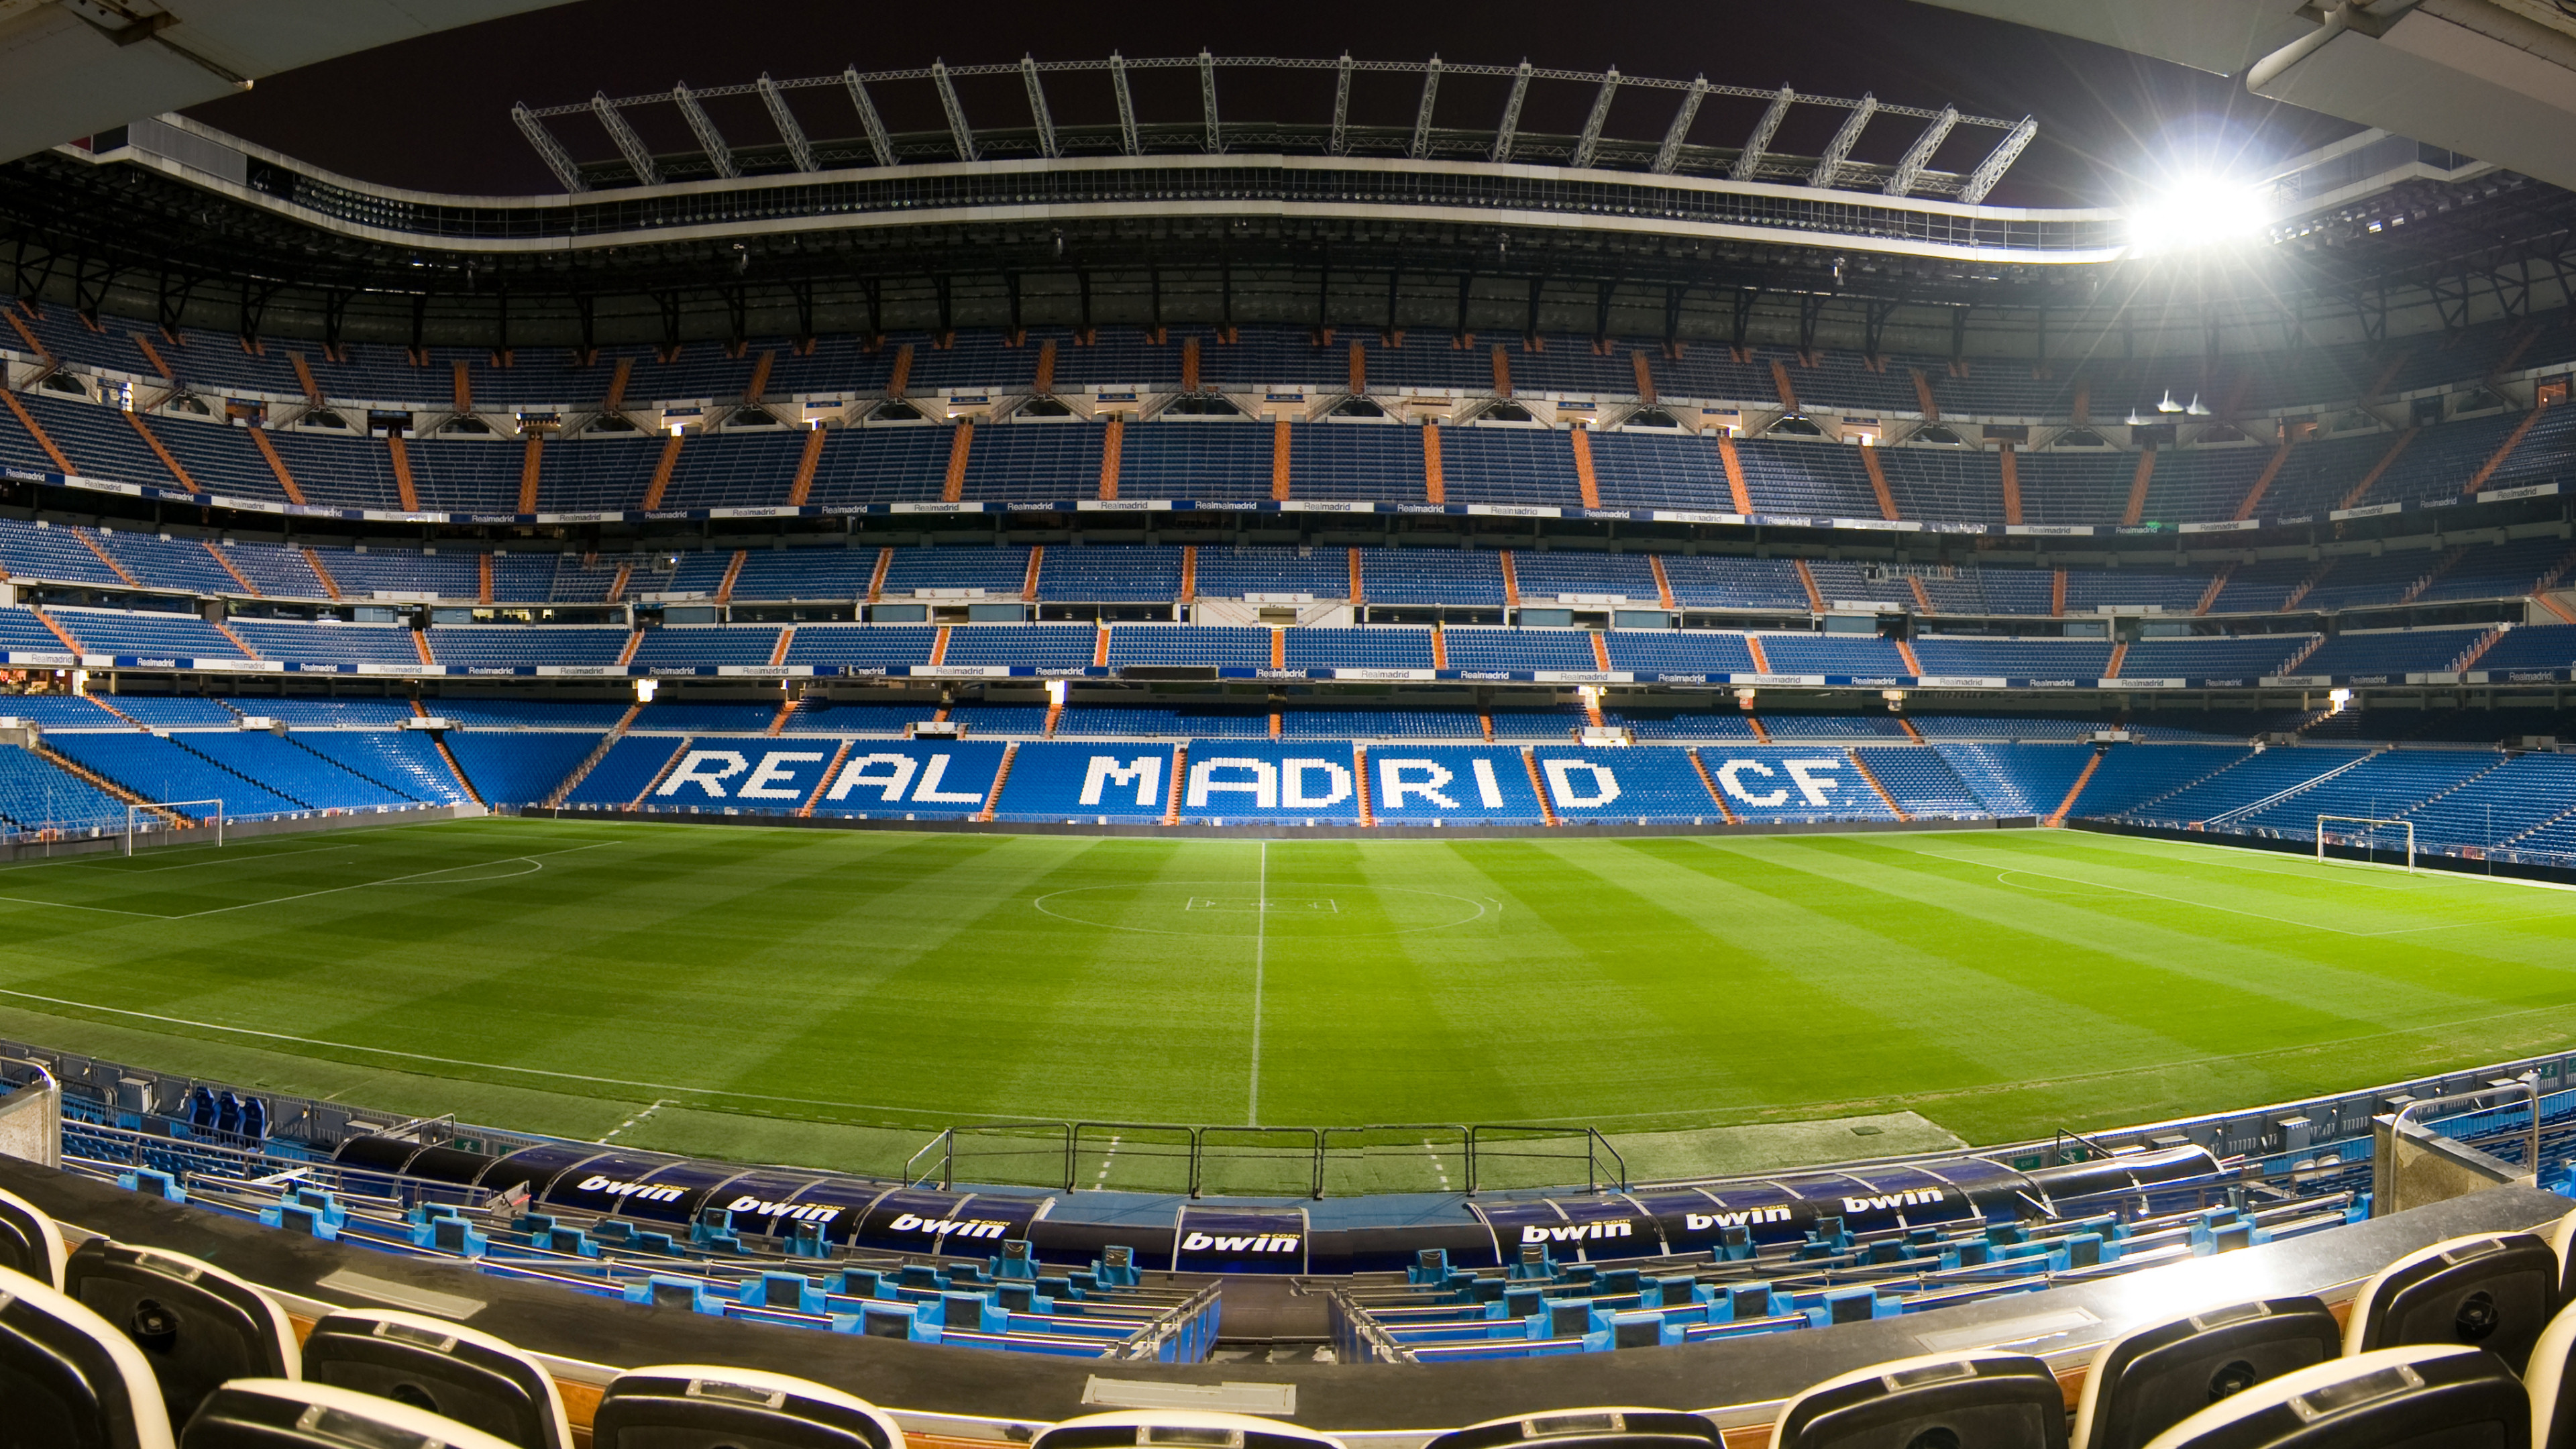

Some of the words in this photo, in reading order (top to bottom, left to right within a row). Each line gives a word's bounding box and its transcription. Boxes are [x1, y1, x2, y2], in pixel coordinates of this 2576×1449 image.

[6, 468, 45, 482] Realmadrid
[85, 480, 121, 491] Realmadrid
[159, 490, 193, 501] Realmadrid
[2498, 488, 2536, 498] Realmadrid
[229, 500, 264, 510] Realmadrid
[2420, 497, 2457, 508] Realmadrid
[822, 505, 867, 514] Realmadrid
[1398, 504, 1444, 513] Realmadrid
[2348, 506, 2383, 517] Realmadrid
[645, 511, 687, 519] Realmadrid
[1585, 510, 1629, 518] Realmadrid
[1676, 513, 1721, 522] Realmadrid
[2277, 515, 2312, 525] Realmadrid
[2200, 522, 2239, 531] Realmadrid
[32, 655, 72, 663] Realmadrid
[137, 658, 174, 667] Realmadrid
[231, 661, 265, 669] Realmadrid
[301, 663, 337, 672] Realmadrid
[380, 665, 422, 674] Realmadrid
[469, 667, 513, 675] Realmadrid
[649, 667, 695, 675] Realmadrid
[839, 667, 885, 675] Rmadrid
[1036, 667, 1083, 676] Realmadrid
[1257, 669, 1306, 678] Realmadrid
[1461, 671, 1509, 679] Realmadrid
[1659, 674, 1705, 682] Realmadrid
[1755, 676, 1801, 684] Realmadrid
[2350, 676, 2387, 684] Realmadrid
[2510, 672, 2552, 681] Realmadrid
[2206, 678, 2241, 686] Realmadrid
[656, 750, 982, 802] REAL
[1079, 755, 1621, 809] MADRID
[577, 1175, 684, 1201] bwin
[1842, 1189, 1944, 1213] bwin
[727, 1196, 840, 1222] bwin
[1686, 1208, 1791, 1230] bwin
[890, 1214, 1006, 1238] bwin
[1522, 1221, 1632, 1242] bwin
[1182, 1232, 1298, 1252] bwin
